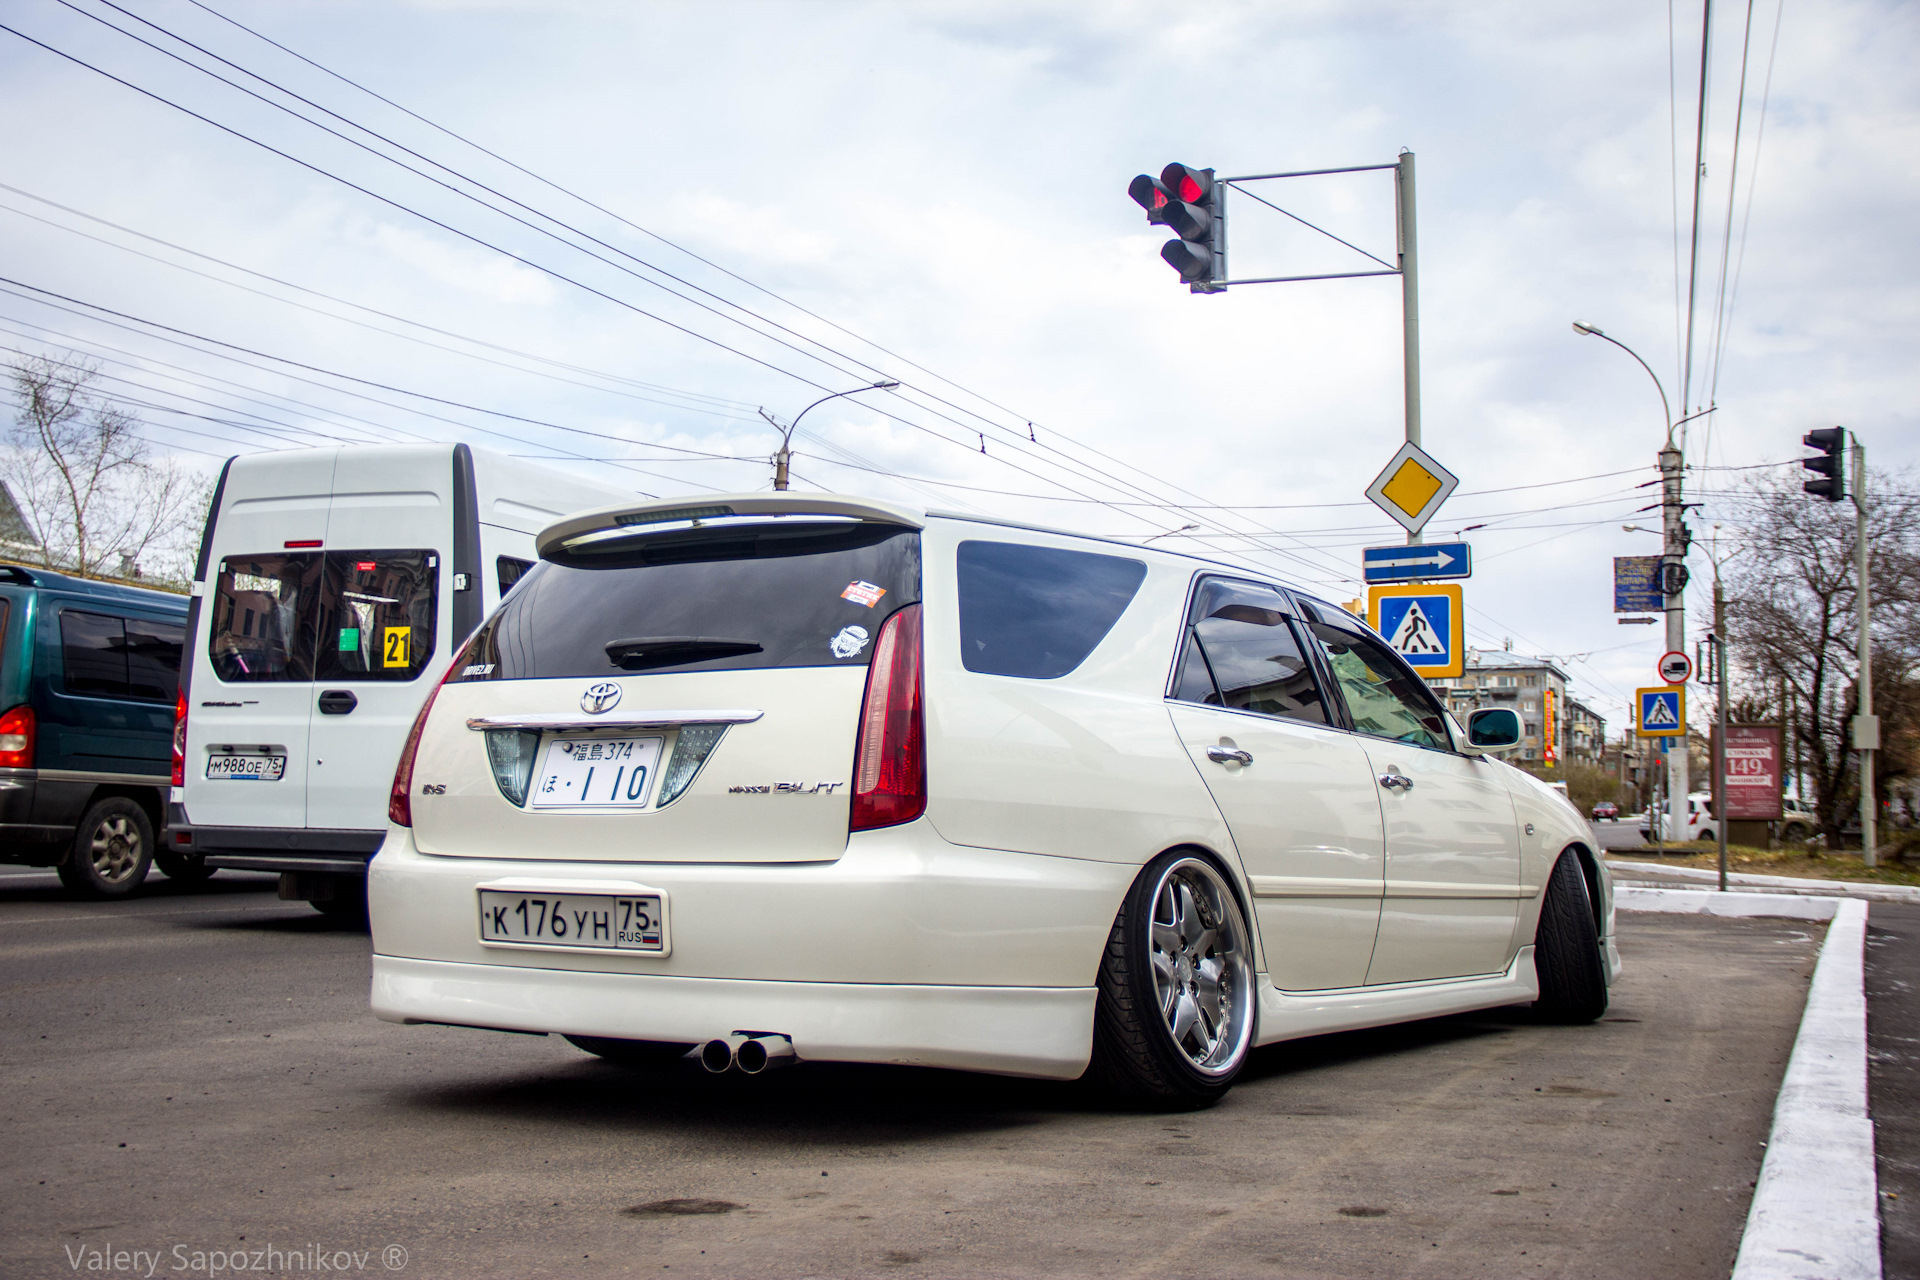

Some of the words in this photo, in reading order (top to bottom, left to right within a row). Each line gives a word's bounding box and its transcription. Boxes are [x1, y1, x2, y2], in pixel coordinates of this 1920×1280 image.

[386, 632, 410, 662] 21
[1727, 758, 1763, 775] 149
[772, 781, 844, 795] BLIT
[618, 931, 642, 943] RUS
